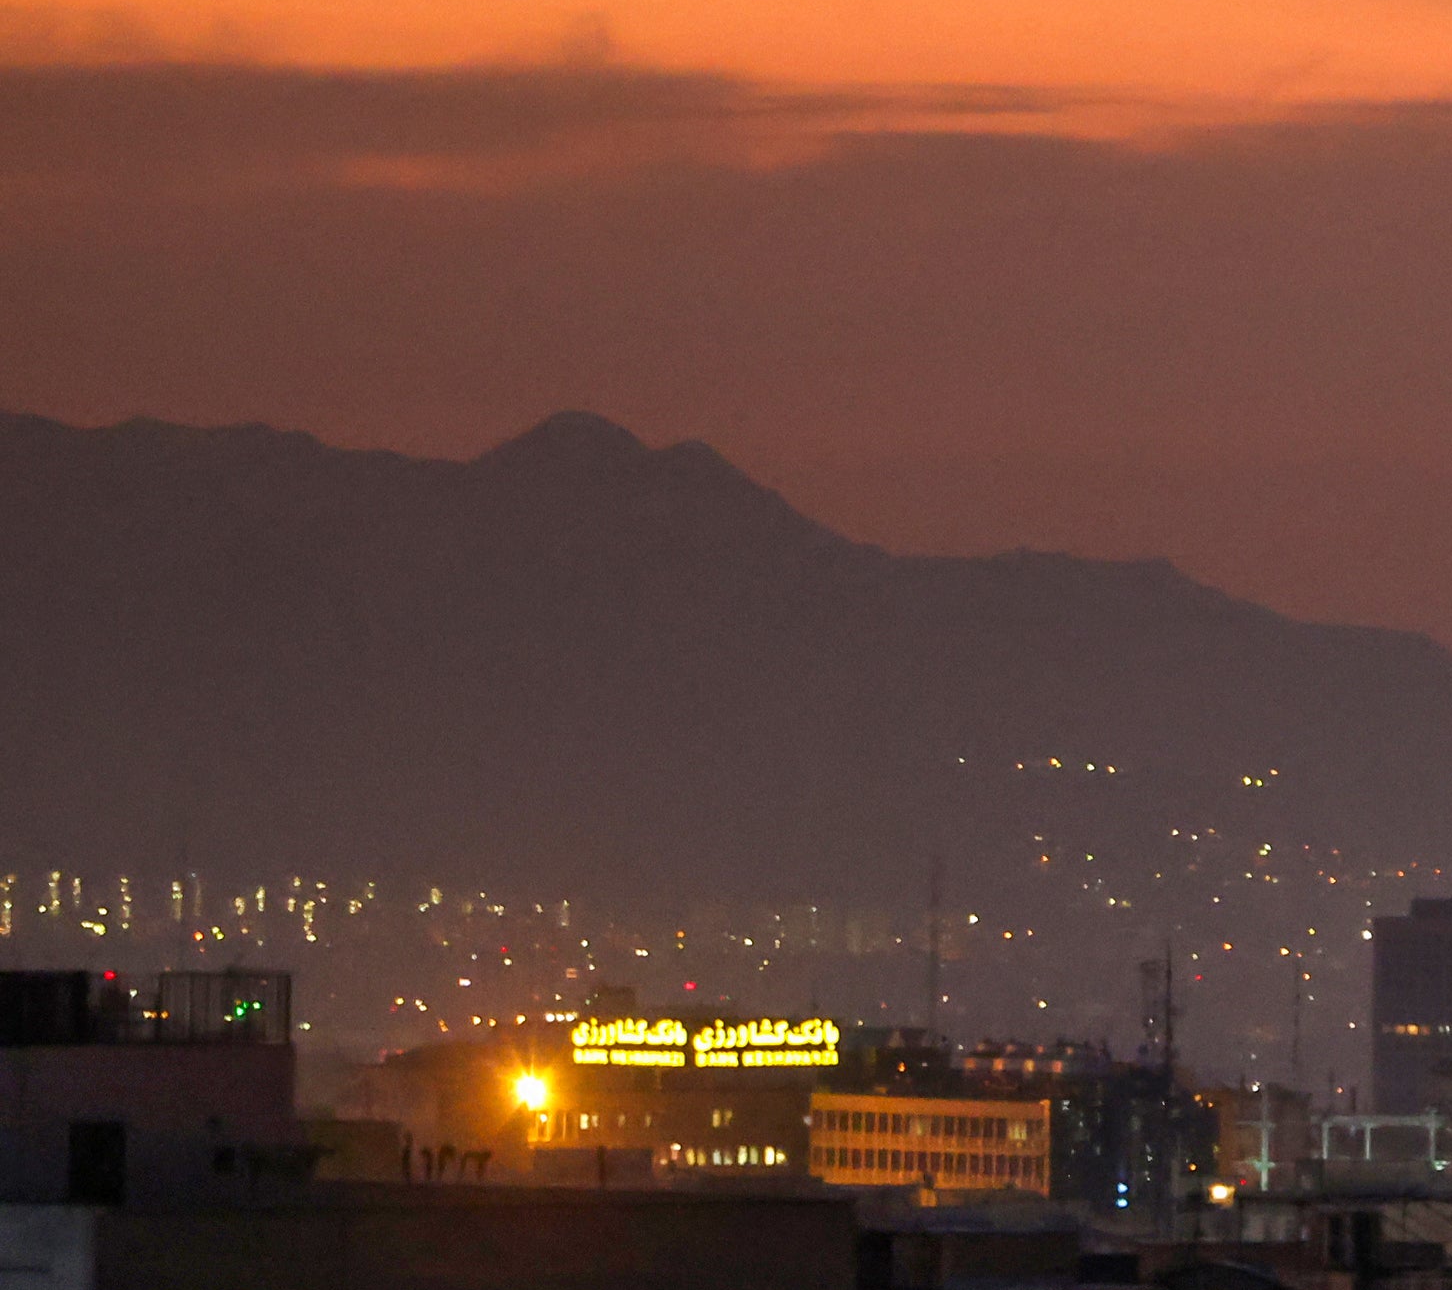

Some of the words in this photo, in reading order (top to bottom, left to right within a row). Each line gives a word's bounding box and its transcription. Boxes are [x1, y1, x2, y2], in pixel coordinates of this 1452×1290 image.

[692, 1018, 786, 1051] کشاورزی
[784, 1018, 839, 1051] بانک
[694, 1050, 738, 1067] BANK
